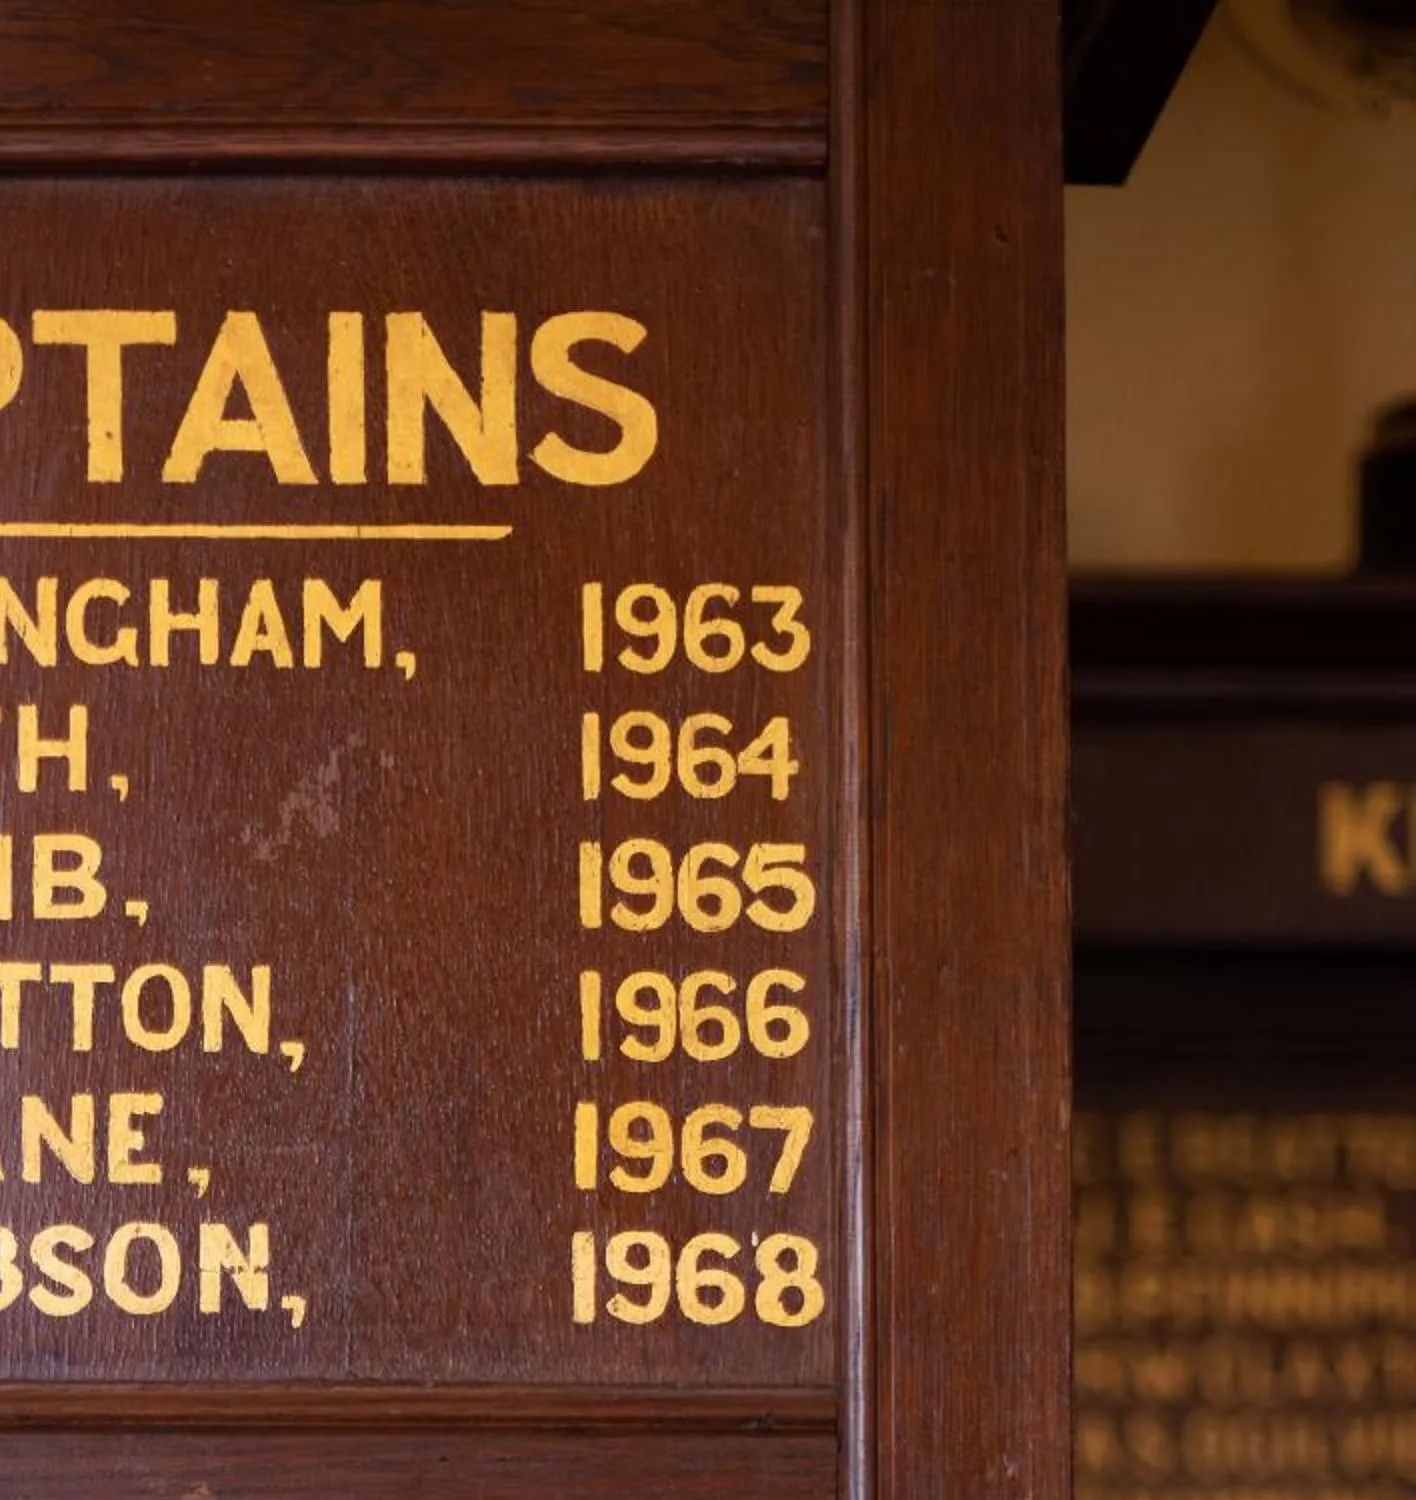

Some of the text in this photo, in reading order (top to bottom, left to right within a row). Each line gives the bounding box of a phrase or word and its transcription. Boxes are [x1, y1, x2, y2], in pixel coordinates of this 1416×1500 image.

[581, 580, 813, 675] 1963
[580, 709, 801, 803] 1964
[578, 836, 817, 934] 1965
[578, 966, 812, 1064] 1966
[572, 1099, 817, 1196] 1967
[570, 1228, 827, 1329] 1968
